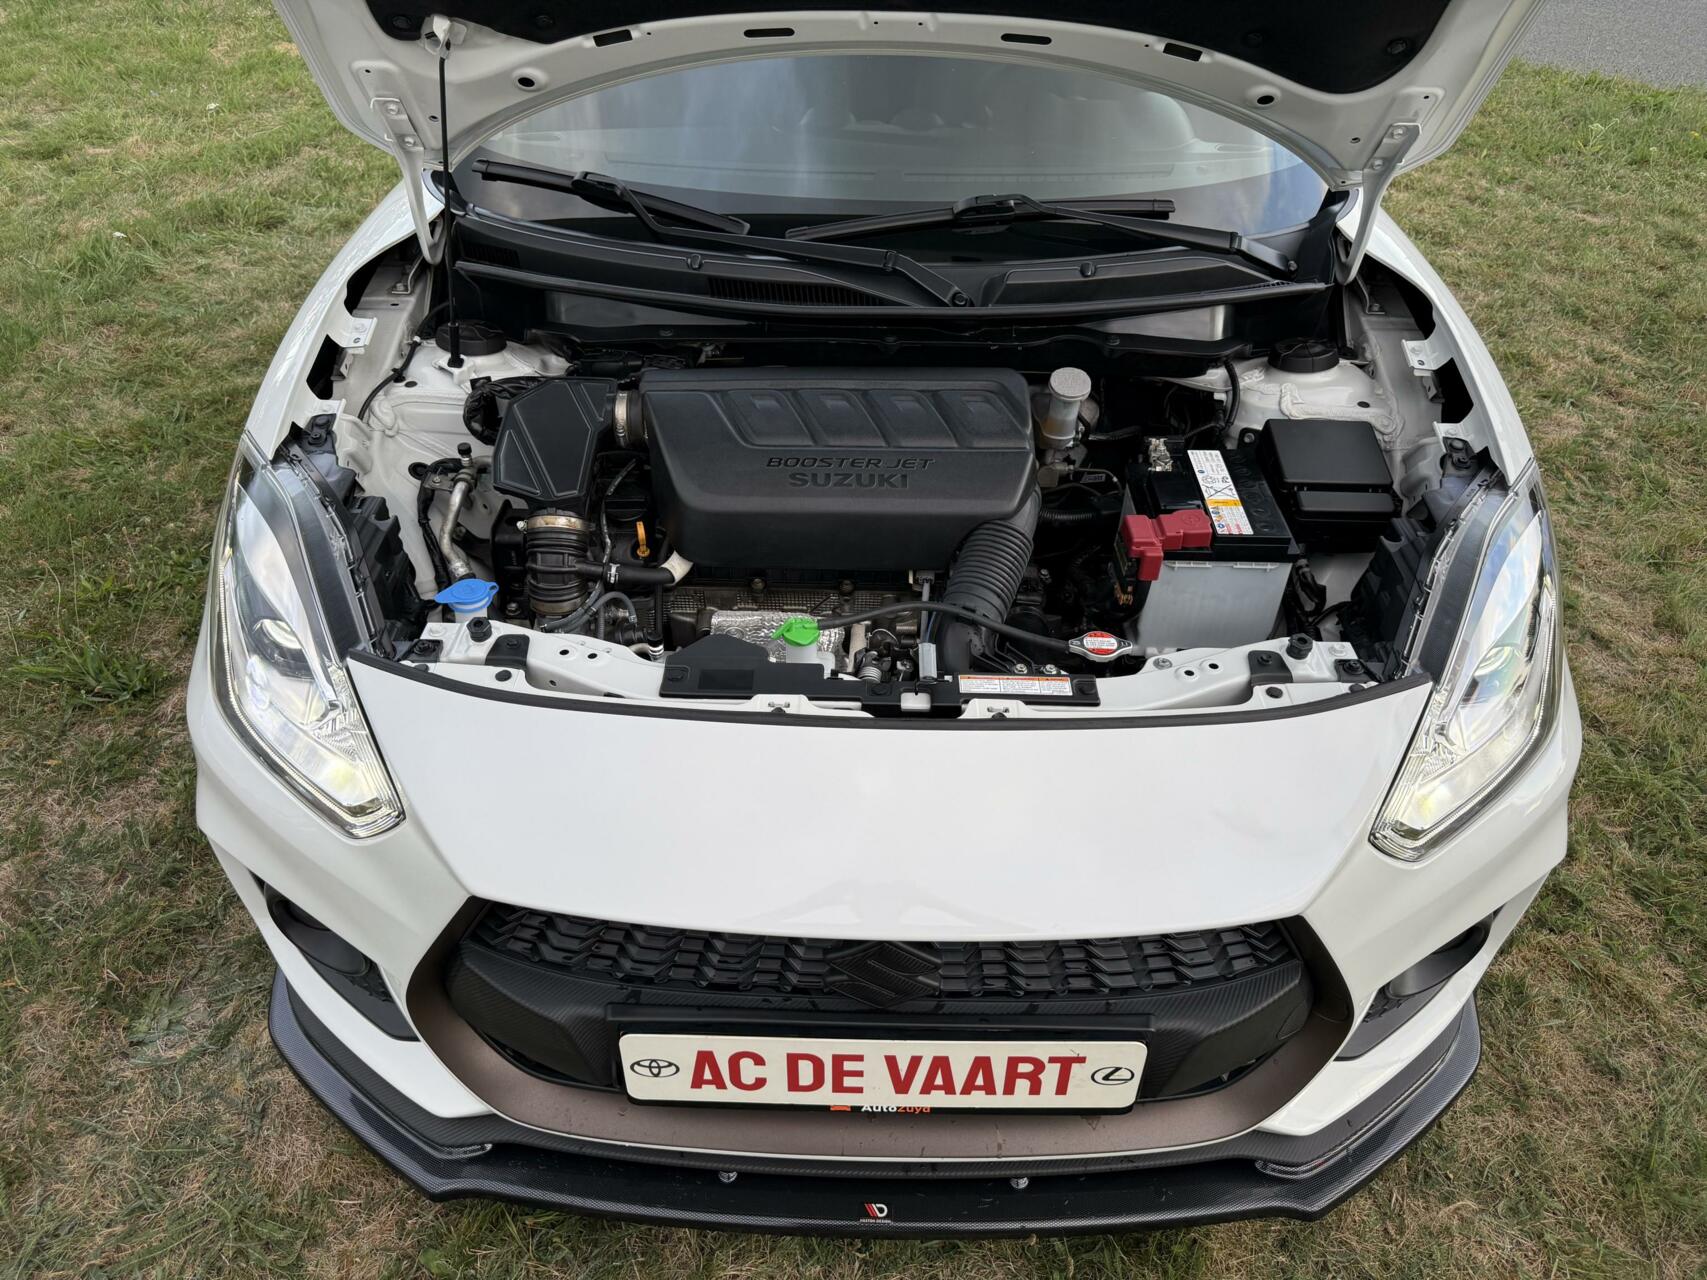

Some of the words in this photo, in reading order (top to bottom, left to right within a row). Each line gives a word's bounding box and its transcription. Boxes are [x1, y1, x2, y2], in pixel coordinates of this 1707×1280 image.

[766, 457, 883, 469] BOOSTER
[886, 457, 936, 470] JET
[788, 472, 910, 489] SUZUKI
[690, 1050, 767, 1091] AC
[786, 1052, 865, 1094] DE
[884, 1055, 1087, 1096] VAART
